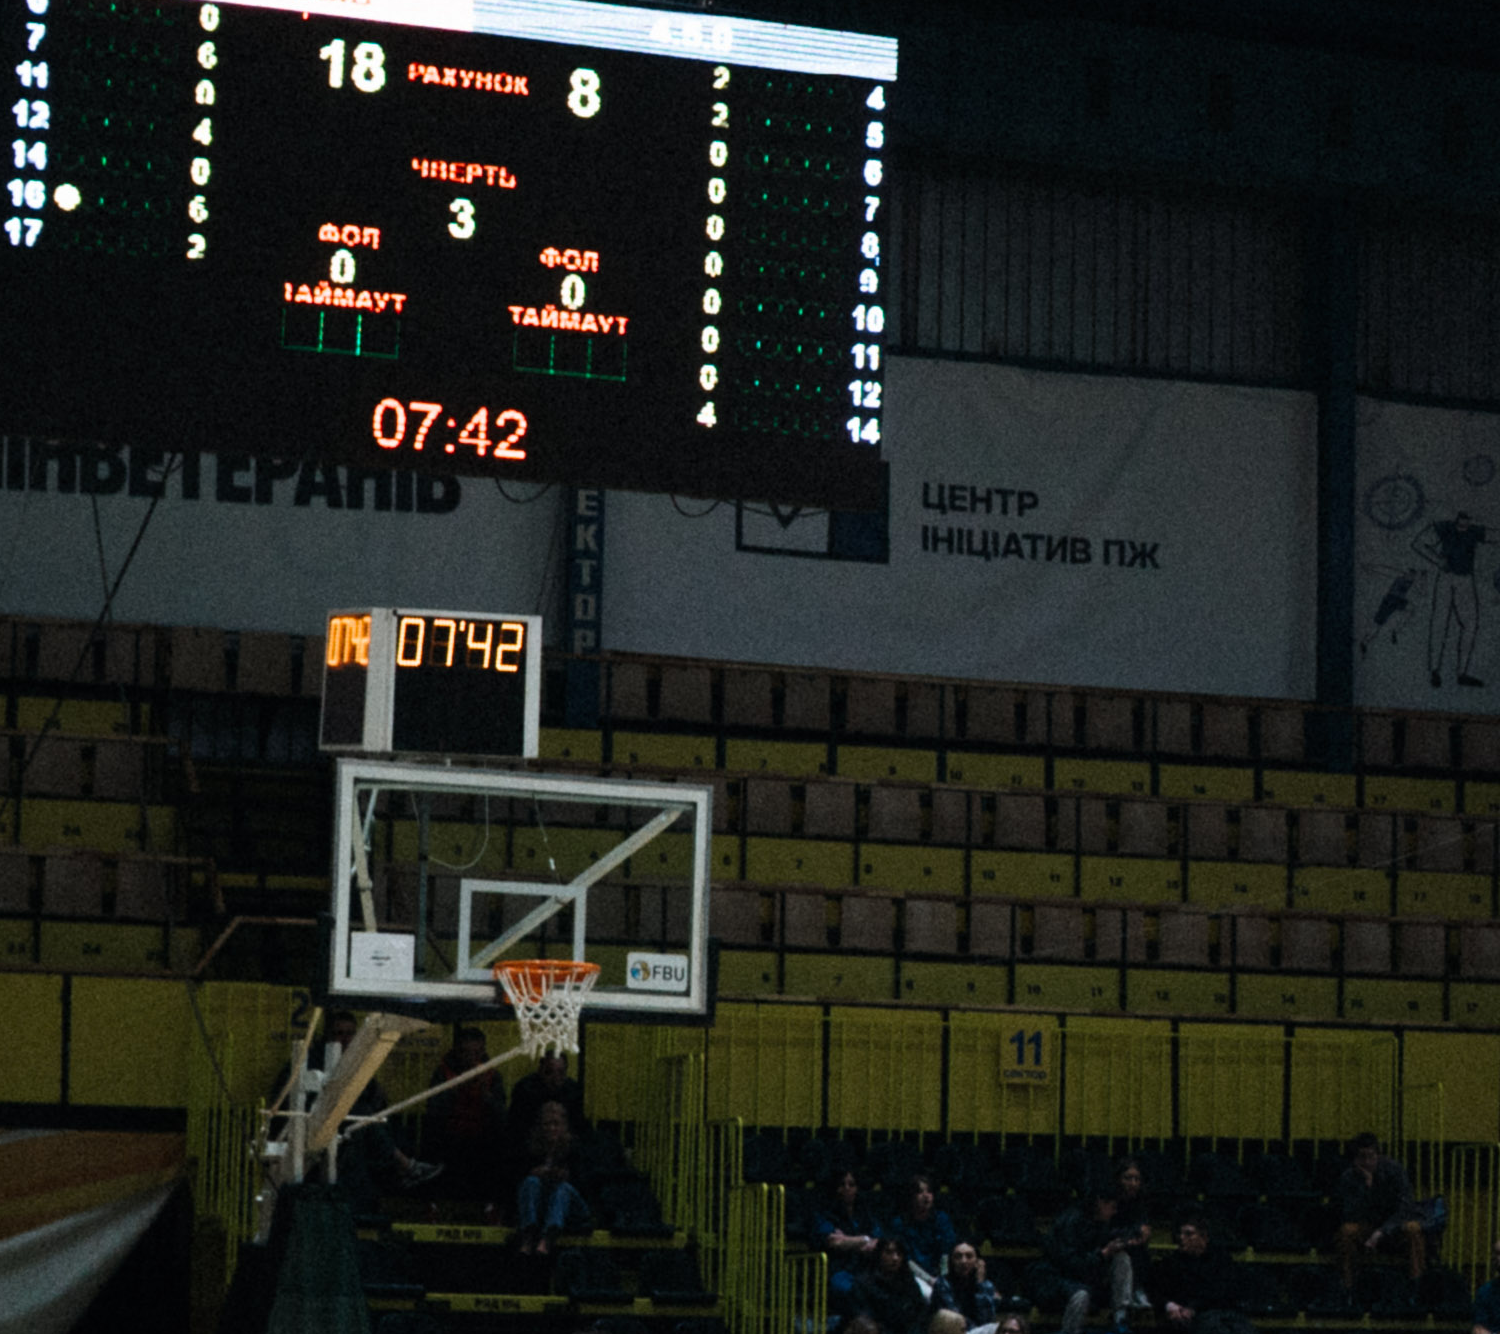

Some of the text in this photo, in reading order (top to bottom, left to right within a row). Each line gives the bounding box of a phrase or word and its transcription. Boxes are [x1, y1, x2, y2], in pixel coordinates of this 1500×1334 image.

[200, 4, 219, 31] 0
[26, 22, 45, 51] 7
[16, 60, 48, 89] 11
[320, 39, 386, 92] 18
[408, 63, 529, 95] РАХУНОК
[713, 66, 730, 89] 2
[567, 68, 600, 118] 8
[866, 86, 885, 110] 4
[12, 99, 50, 129] 12
[712, 102, 728, 127] 2
[193, 118, 212, 145] 4
[865, 121, 884, 148] 5
[12, 139, 47, 170] 14
[710, 141, 728, 167] 0
[191, 157, 210, 185] 0
[412, 158, 516, 189] ЧВЕРТЬ
[863, 159, 882, 186] 6
[7, 179, 46, 209] 16
[708, 178, 726, 204] 0
[189, 195, 208, 223] 6
[448, 198, 475, 239] 3
[865, 196, 880, 221] 7
[4, 217, 43, 247] 17
[318, 223, 380, 251] ФОЛ
[706, 215, 724, 240] 0
[187, 234, 206, 259] 2
[540, 247, 599, 273] ФОЛ
[860, 232, 880, 261] 8
[330, 249, 355, 284] 0
[705, 251, 723, 277] 0
[561, 274, 585, 310] 0
[859, 268, 878, 293] 9
[703, 288, 721, 314] 0
[508, 303, 629, 335] ТАЙМАУТ
[852, 304, 884, 333] 10
[702, 326, 720, 353] 0
[851, 343, 879, 371] 11
[700, 365, 718, 390] 0
[848, 380, 881, 408] 12
[697, 402, 716, 427] 4
[373, 398, 527, 460] 07:42
[846, 417, 880, 444] 14
[922, 480, 1039, 518] ЦЕНТР
[922, 525, 1160, 570] ІНІЦІАТИВ ПЖ
[570, 487, 601, 656] ЕКТОР
[652, 964, 686, 983] FBU
[290, 990, 310, 1028] 2
[1009, 1029, 1042, 1066] 11
